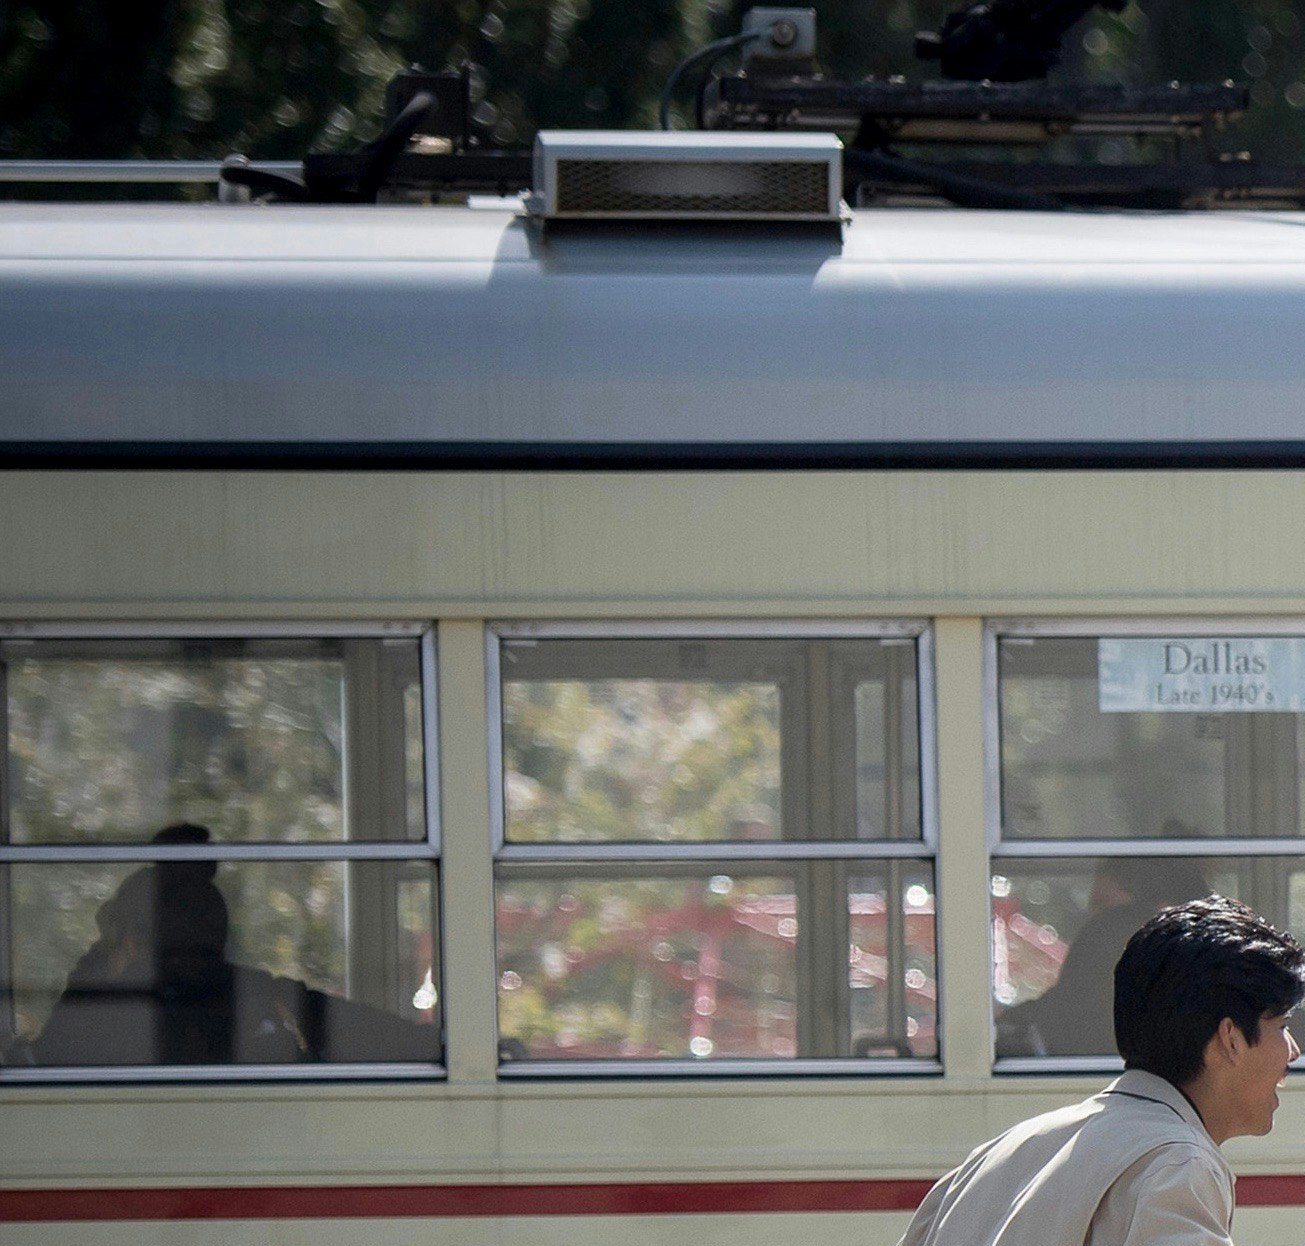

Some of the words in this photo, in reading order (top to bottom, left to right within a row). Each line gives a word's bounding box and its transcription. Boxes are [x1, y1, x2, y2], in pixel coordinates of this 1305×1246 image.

[1162, 641, 1268, 675] Dallas
[1155, 683, 1200, 705] Late
[1211, 683, 1275, 705] 1940's
